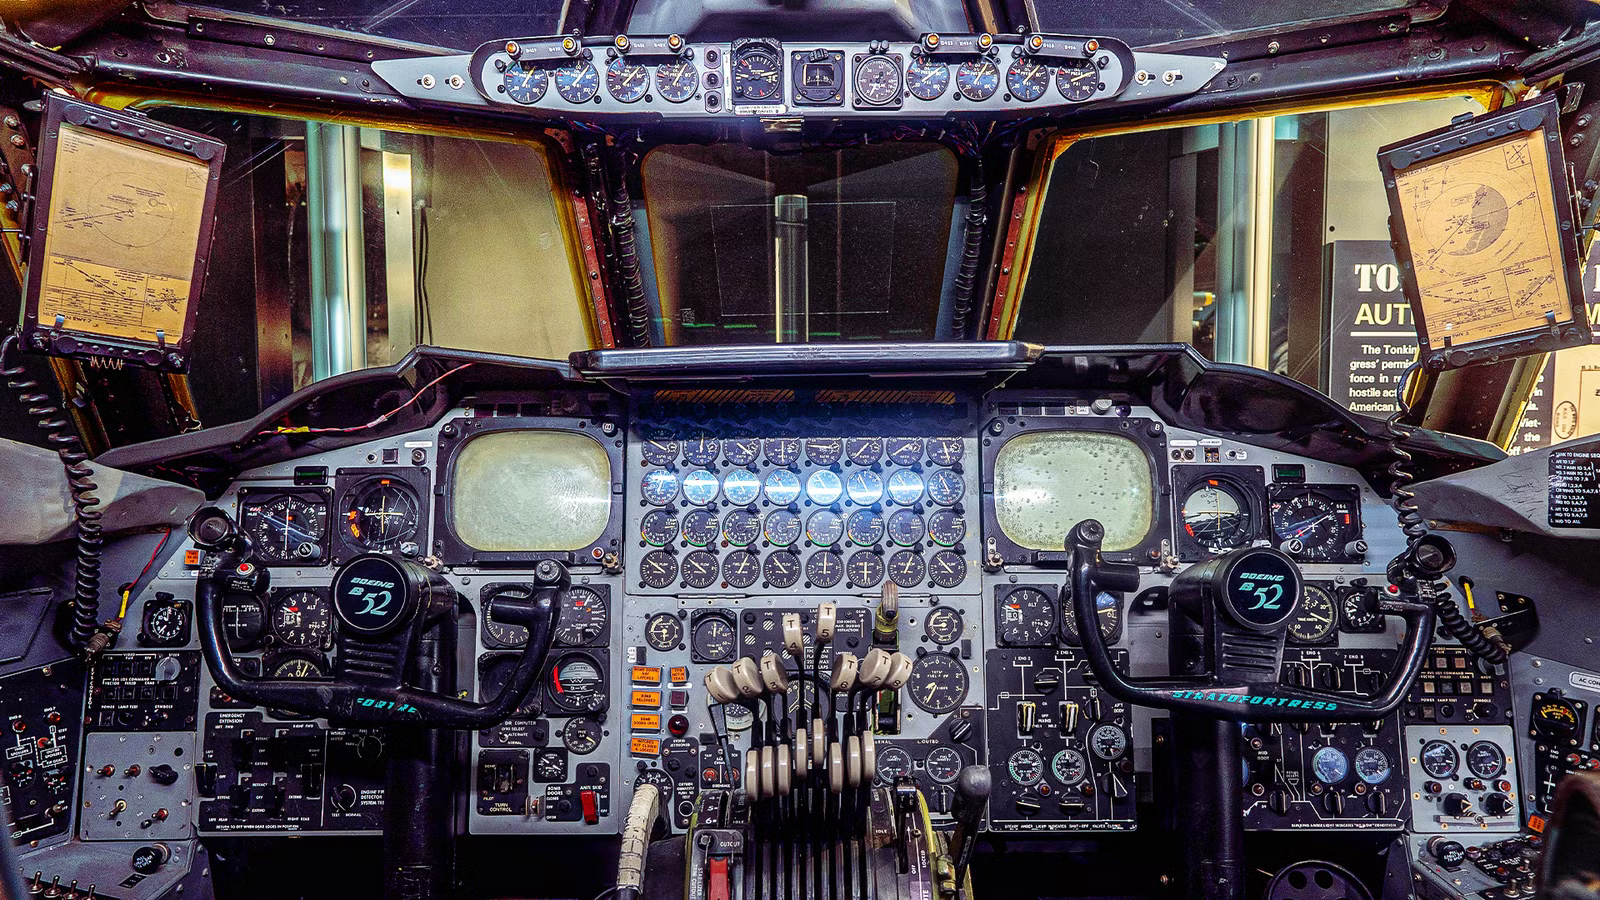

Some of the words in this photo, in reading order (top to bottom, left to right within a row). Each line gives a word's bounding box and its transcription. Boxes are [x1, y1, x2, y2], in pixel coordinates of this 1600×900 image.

[1354, 263, 1403, 292] TO
[1361, 345, 1381, 355] The
[1349, 374, 1374, 384] force
[1380, 374, 1389, 384] in
[1349, 387, 1381, 397] hostile
[1348, 402, 1394, 412] American
[1524, 432, 1541, 441] the
[1240, 572, 1285, 582] BOEING
[350, 577, 395, 589] BOEING
[348, 586, 364, 596] B
[1238, 582, 1255, 592] B
[1248, 583, 1284, 610] 52
[355, 590, 392, 616] 52
[821, 629, 830, 638] 5
[770, 681, 778, 689] 3
[840, 681, 849, 689] 6
[892, 679, 901, 687] 8
[742, 685, 751, 694] 2
[1172, 691, 1338, 711] STRATOFORTRESS
